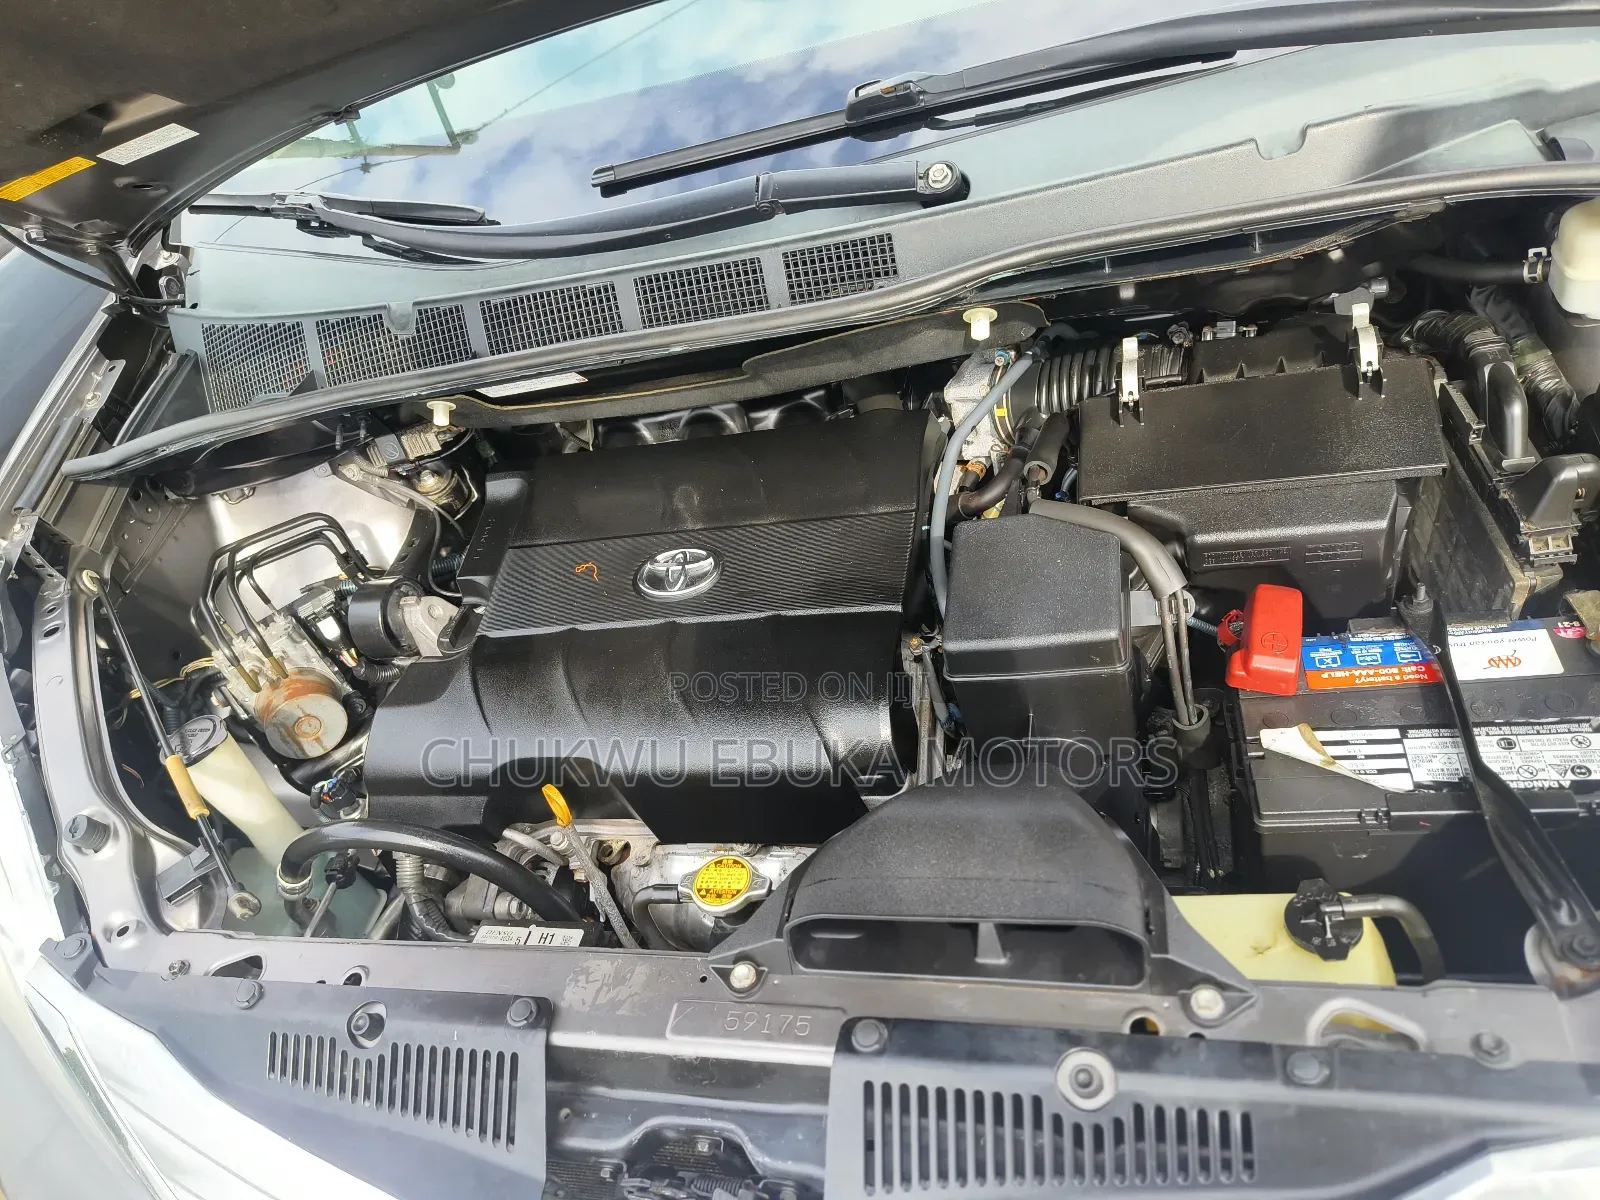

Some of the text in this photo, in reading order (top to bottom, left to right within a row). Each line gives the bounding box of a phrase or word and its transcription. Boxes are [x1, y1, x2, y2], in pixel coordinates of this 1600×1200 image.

[1488, 656, 1520, 669] AAA
[1321, 667, 1398, 678] 800-AAA-HELP
[1403, 673, 1427, 681] Need
[1354, 675, 1392, 683] battery?
[724, 1010, 813, 1036] 59175
